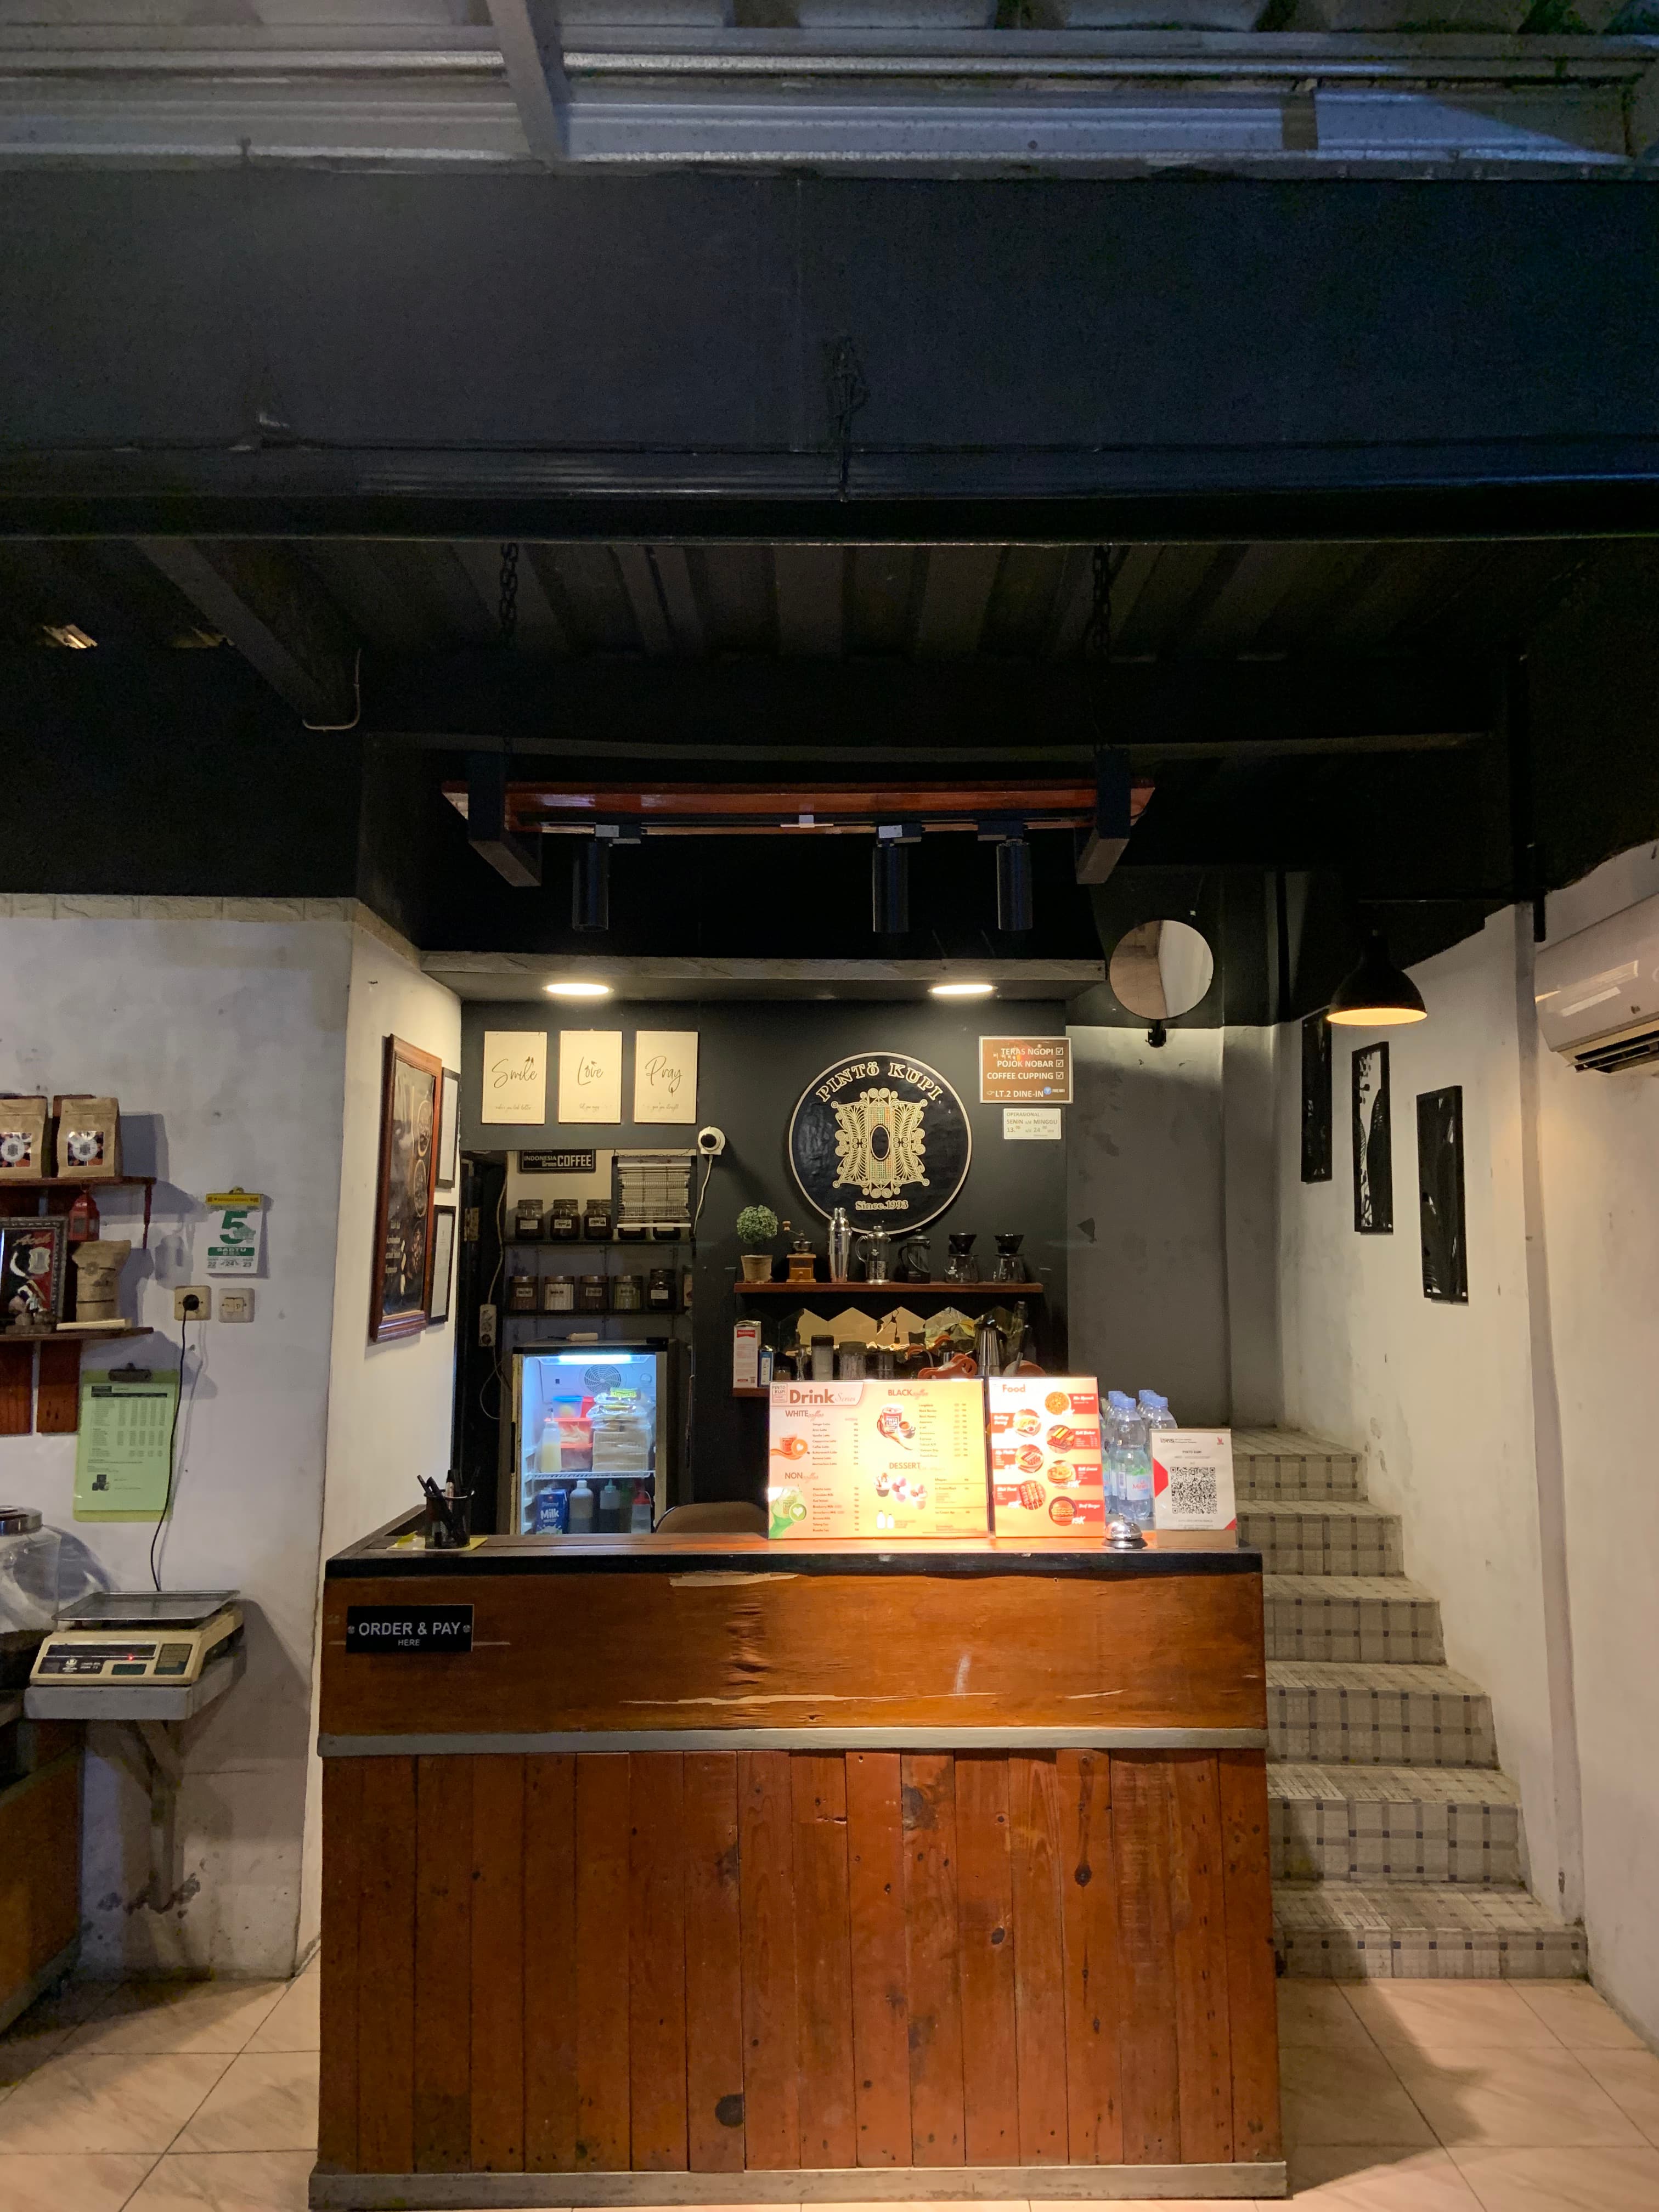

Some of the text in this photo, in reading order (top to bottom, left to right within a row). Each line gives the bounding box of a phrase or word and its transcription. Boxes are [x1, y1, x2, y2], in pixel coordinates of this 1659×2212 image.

[492, 1057, 538, 1088] Smile
[577, 1057, 603, 1086] Love
[645, 1056, 682, 1093] Pray
[888, 1063, 944, 1101] KUPI
[557, 1155, 592, 1167] COFFEE
[219, 1210, 249, 1245] 5
[1002, 1383, 1025, 1393] Food
[789, 1389, 834, 1404] Drink
[785, 1471, 803, 1480] NON
[540, 1508, 560, 1520] Milk
[359, 1622, 461, 1635] ORDER & PAY
